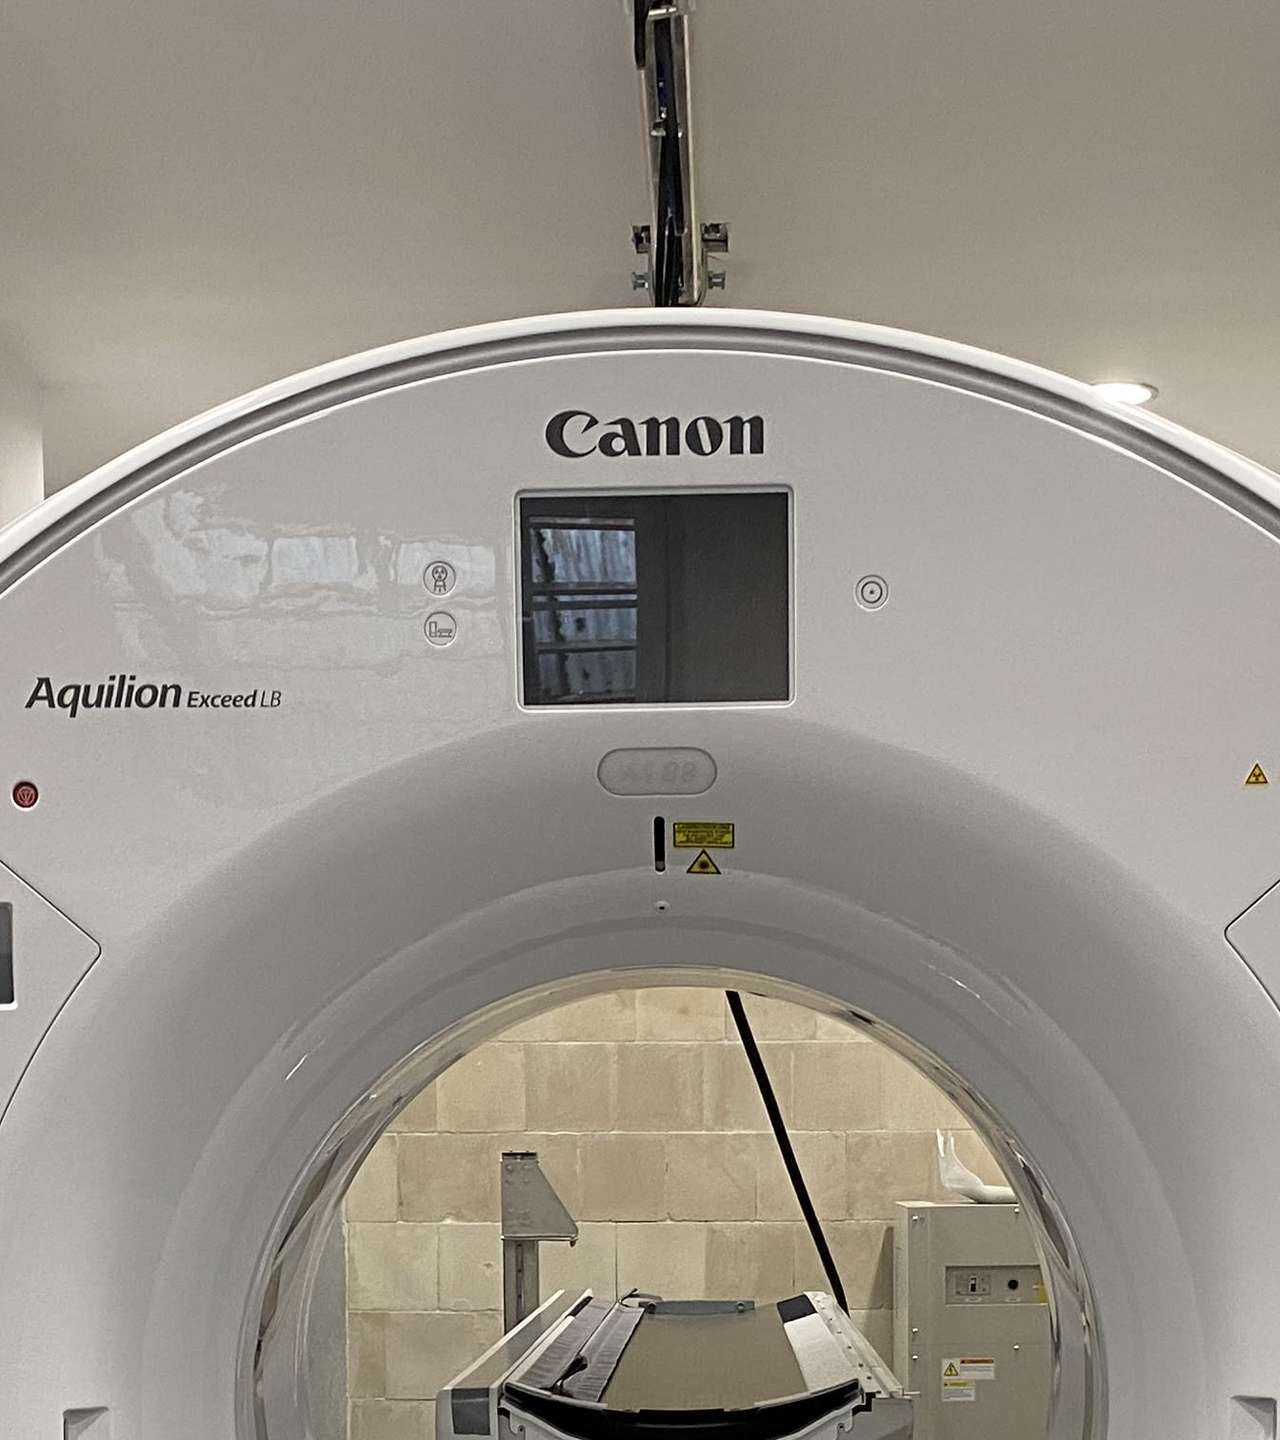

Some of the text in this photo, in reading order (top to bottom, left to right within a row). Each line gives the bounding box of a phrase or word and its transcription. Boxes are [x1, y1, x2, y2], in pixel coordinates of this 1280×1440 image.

[545, 409, 765, 459] Canon
[24, 674, 282, 718] Aquilion Exceed LB
